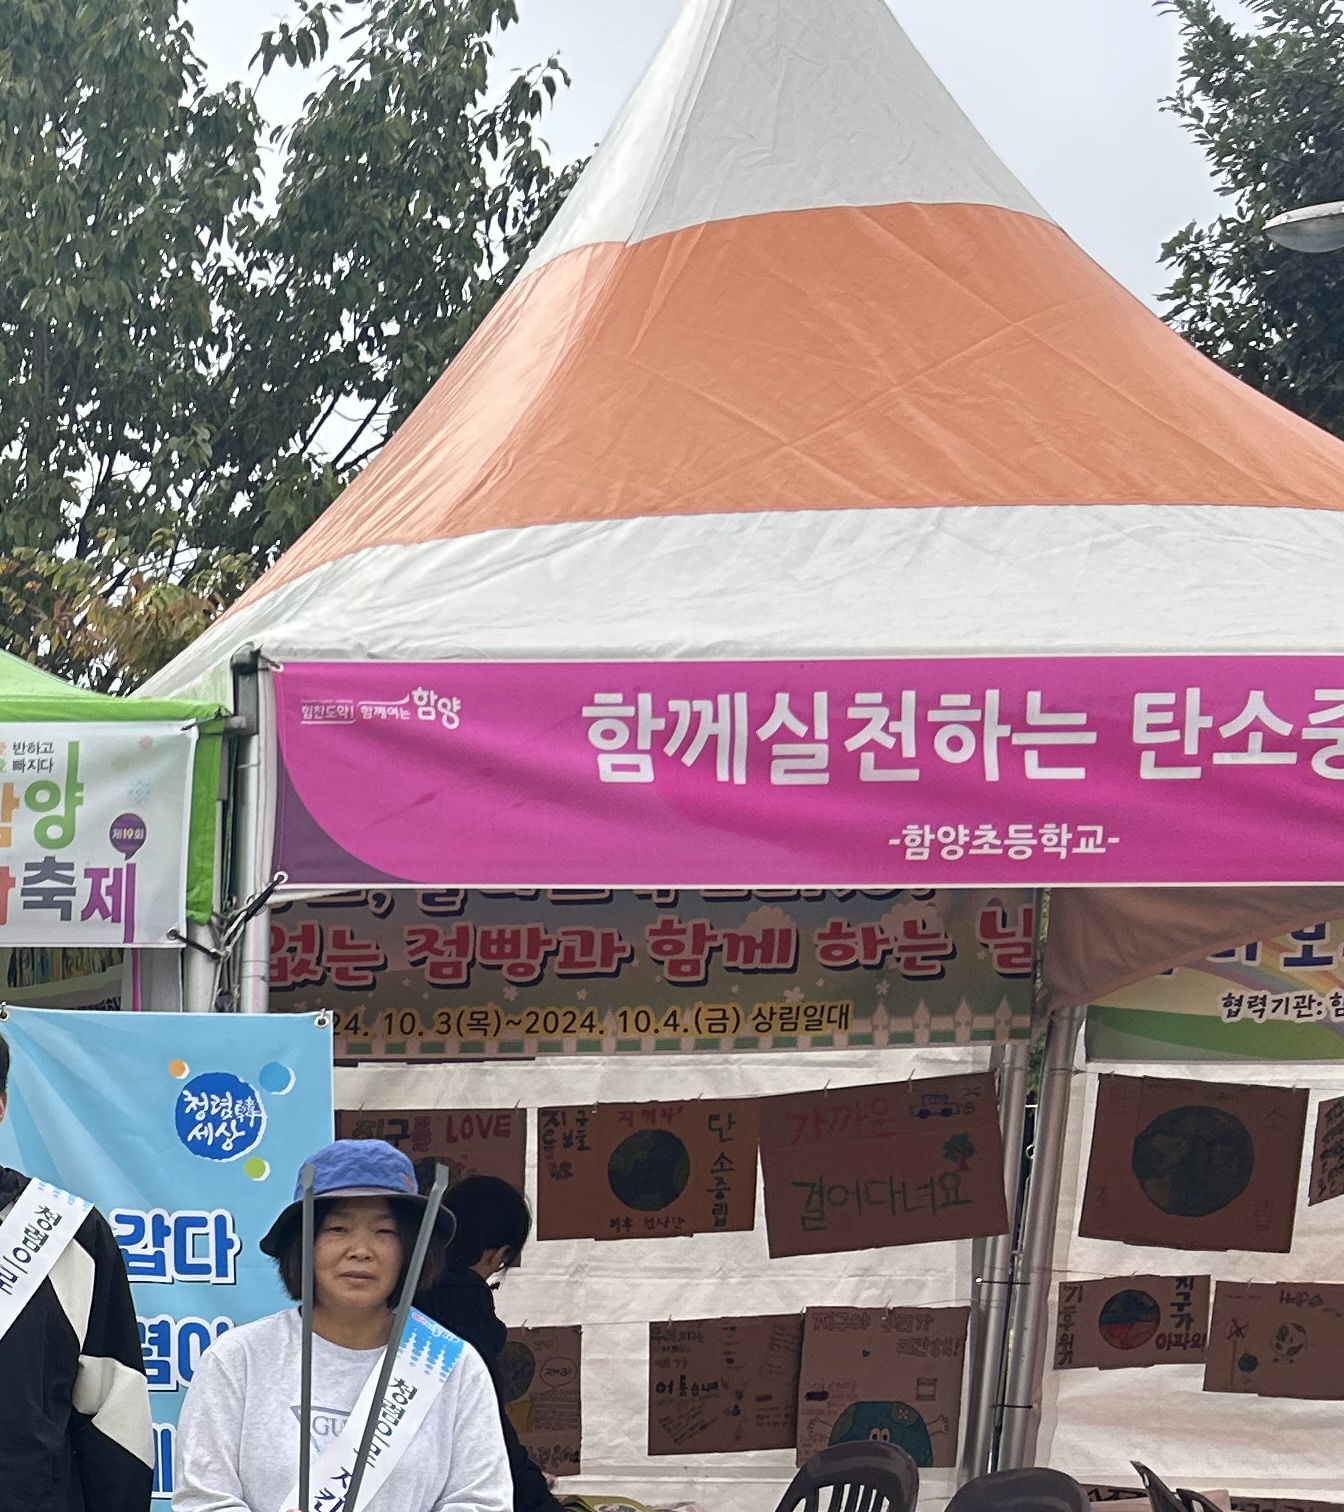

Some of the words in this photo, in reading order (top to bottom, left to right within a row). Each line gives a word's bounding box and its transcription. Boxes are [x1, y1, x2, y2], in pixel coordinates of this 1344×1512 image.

[412, 687, 462, 730] 함양
[12, 740, 54, 755] 반하고
[583, 689, 1099, 787] 함께실천하는
[12, 757, 54, 773] 빠지다
[889, 823, 1120, 861] -함양초등학교-
[407, 923, 624, 982] 점빵과
[649, 918, 797, 980] 함께
[817, 919, 949, 972] 하는
[752, 1003, 850, 1032] 상림일대
[1222, 992, 1323, 1020] 협력기관:
[186, 1121, 248, 1151] 세상
[445, 1113, 512, 1144] LOVE
[114, 1210, 236, 1283] 갑다
